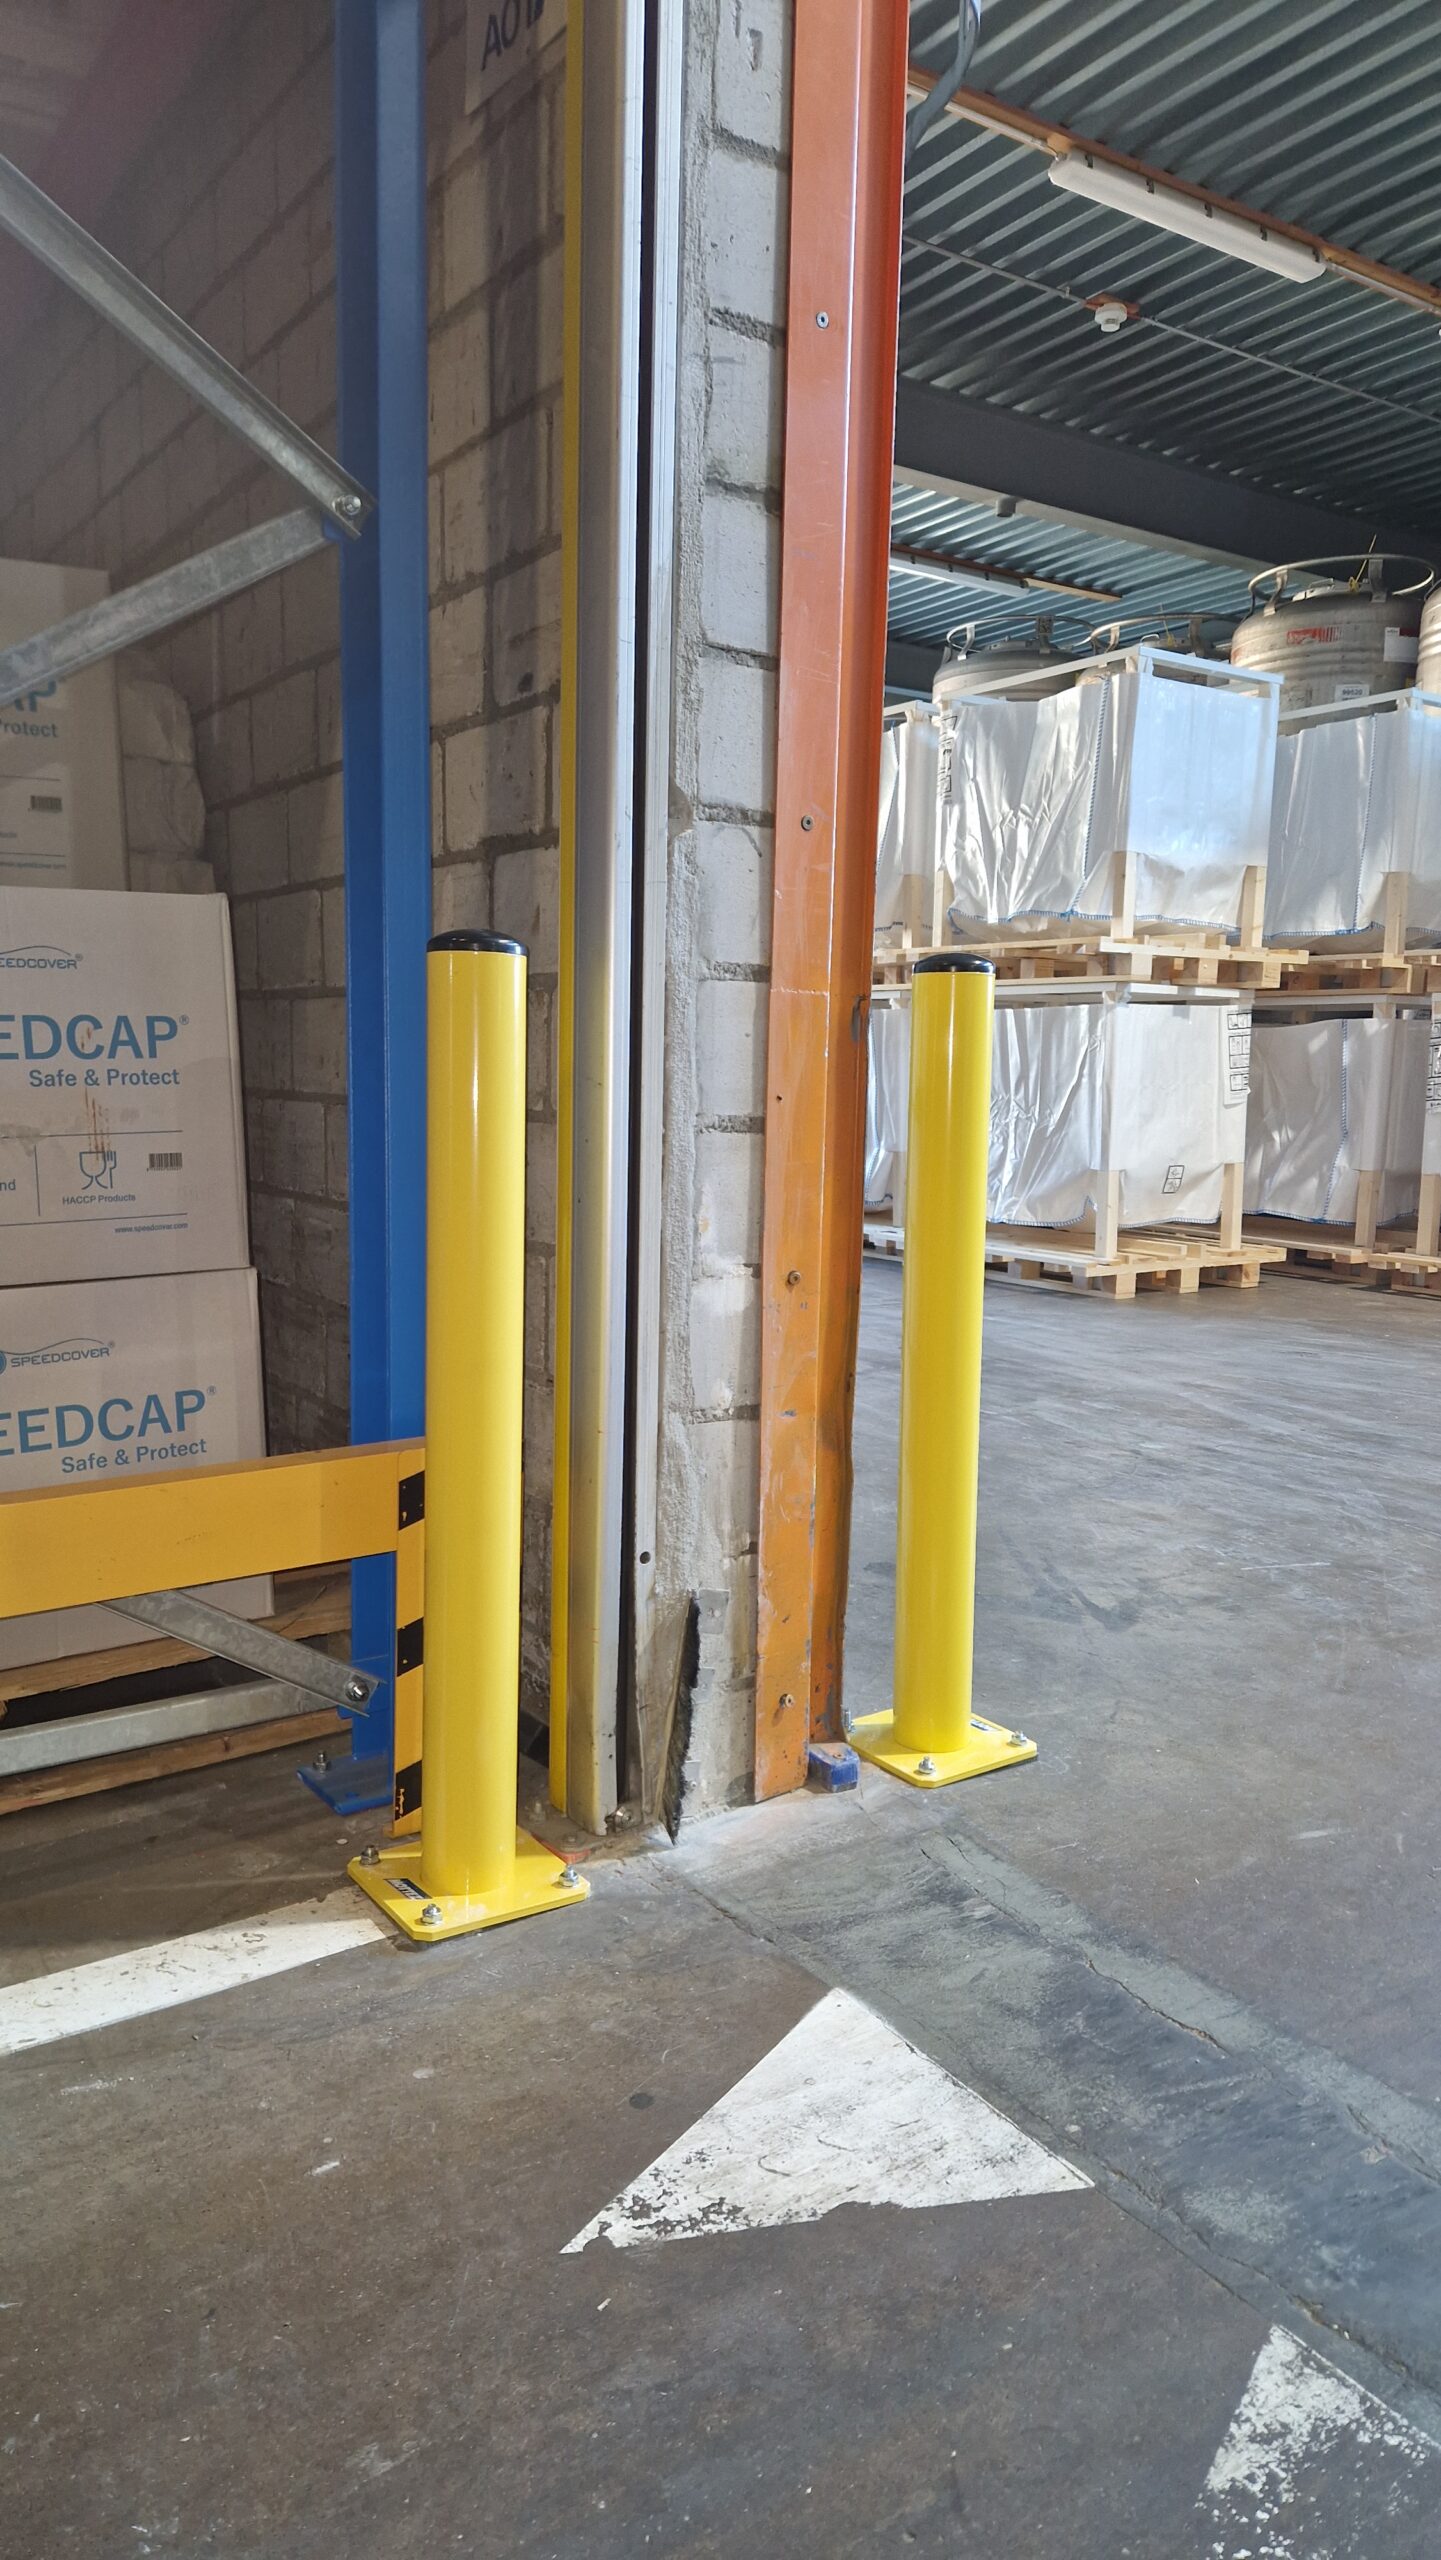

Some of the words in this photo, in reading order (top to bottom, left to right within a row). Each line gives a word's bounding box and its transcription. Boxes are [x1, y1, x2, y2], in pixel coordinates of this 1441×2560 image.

[0, 718, 58, 738] rotect
[29, 1068, 77, 1087] Safe
[84, 1069, 100, 1087] &
[107, 1068, 180, 1086] Protect
[62, 1195, 96, 1205] HACCP
[98, 1194, 136, 1203] Products
[11, 1347, 110, 1368] SPEEDCOVER
[62, 1453, 108, 1473] Safe
[114, 1448, 130, 1466] &
[136, 1438, 207, 1463] Protect
